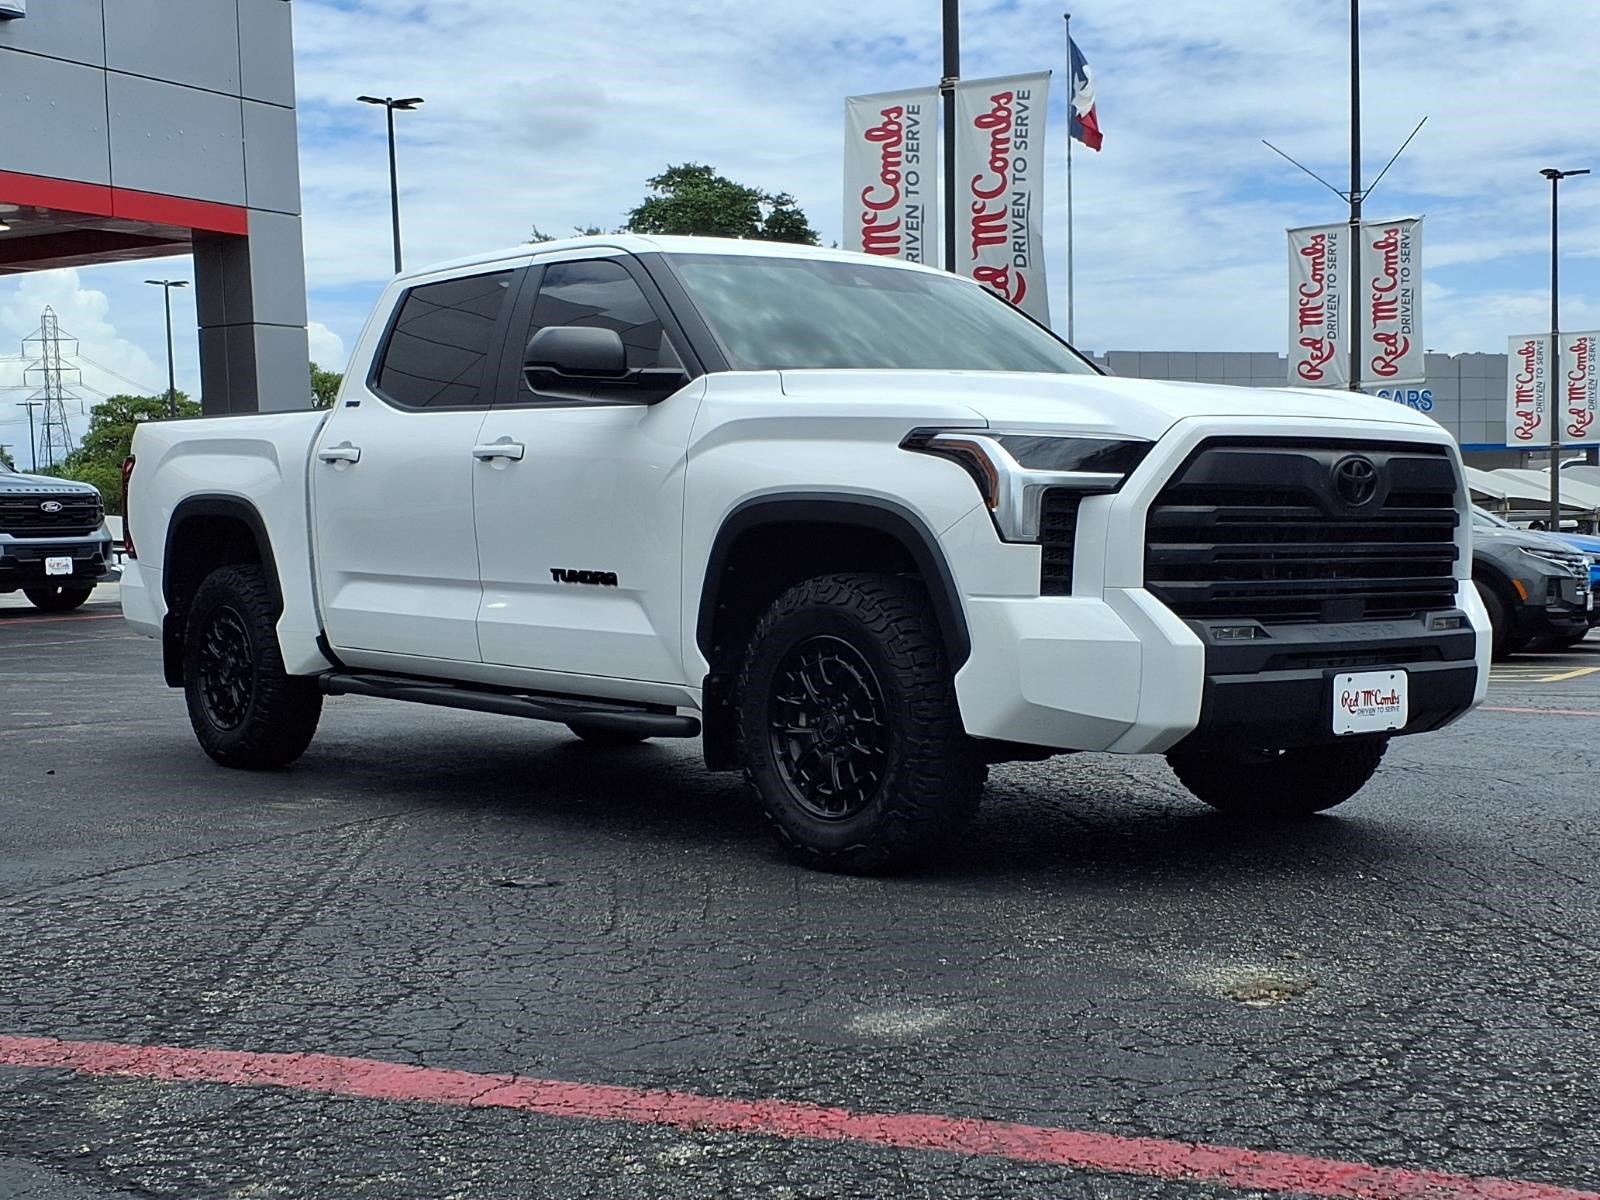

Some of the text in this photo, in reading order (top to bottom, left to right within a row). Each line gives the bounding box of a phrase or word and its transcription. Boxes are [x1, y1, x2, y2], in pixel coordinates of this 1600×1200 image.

[905, 104, 921, 264] RIVEN TO SERVE
[971, 91, 1014, 261] McCombs
[1011, 89, 1031, 268] DRIVEN TO SERVE
[1297, 233, 1335, 381] Red McCombs
[1326, 232, 1337, 340] DRIVEN TO SERVE
[1371, 228, 1409, 377] Red McCombs
[1400, 227, 1412, 335] DRIVEN TO SERVE
[1514, 340, 1541, 440] Red McCombs
[1536, 339, 1544, 365] SERVE
[1536, 367, 1543, 378] TO
[1567, 337, 1593, 438] Red McCombs
[1588, 336, 1597, 410] DRIVEN TO SERVE
[549, 567, 618, 587] TUNDRA
[1341, 688, 1401, 714] Red McCombs
[1357, 707, 1377, 715] DRIVEN
[1385, 705, 1400, 713] SERVE
